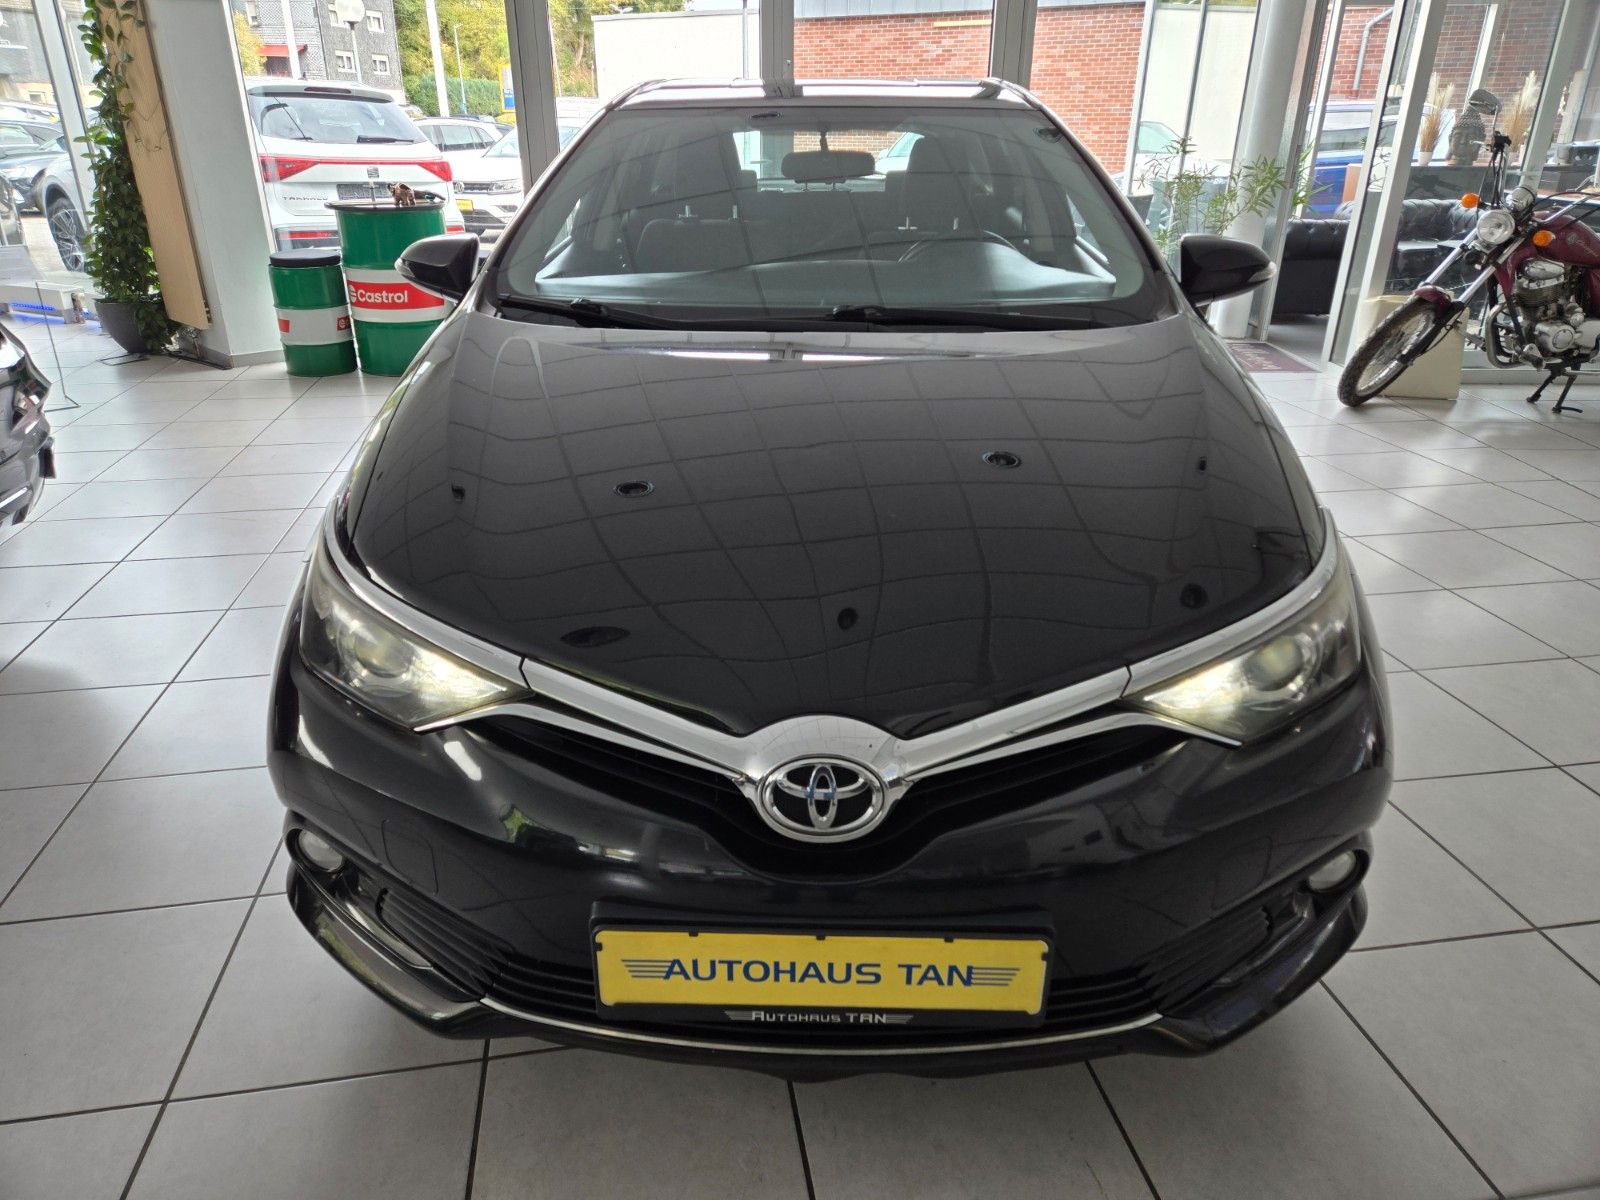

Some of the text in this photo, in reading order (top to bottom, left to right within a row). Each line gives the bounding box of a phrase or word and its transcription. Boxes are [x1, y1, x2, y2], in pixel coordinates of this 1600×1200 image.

[357, 289, 408, 303] Castrol
[663, 958, 974, 987] AUTOHAUS TAN
[845, 1012, 887, 1024] TAN
